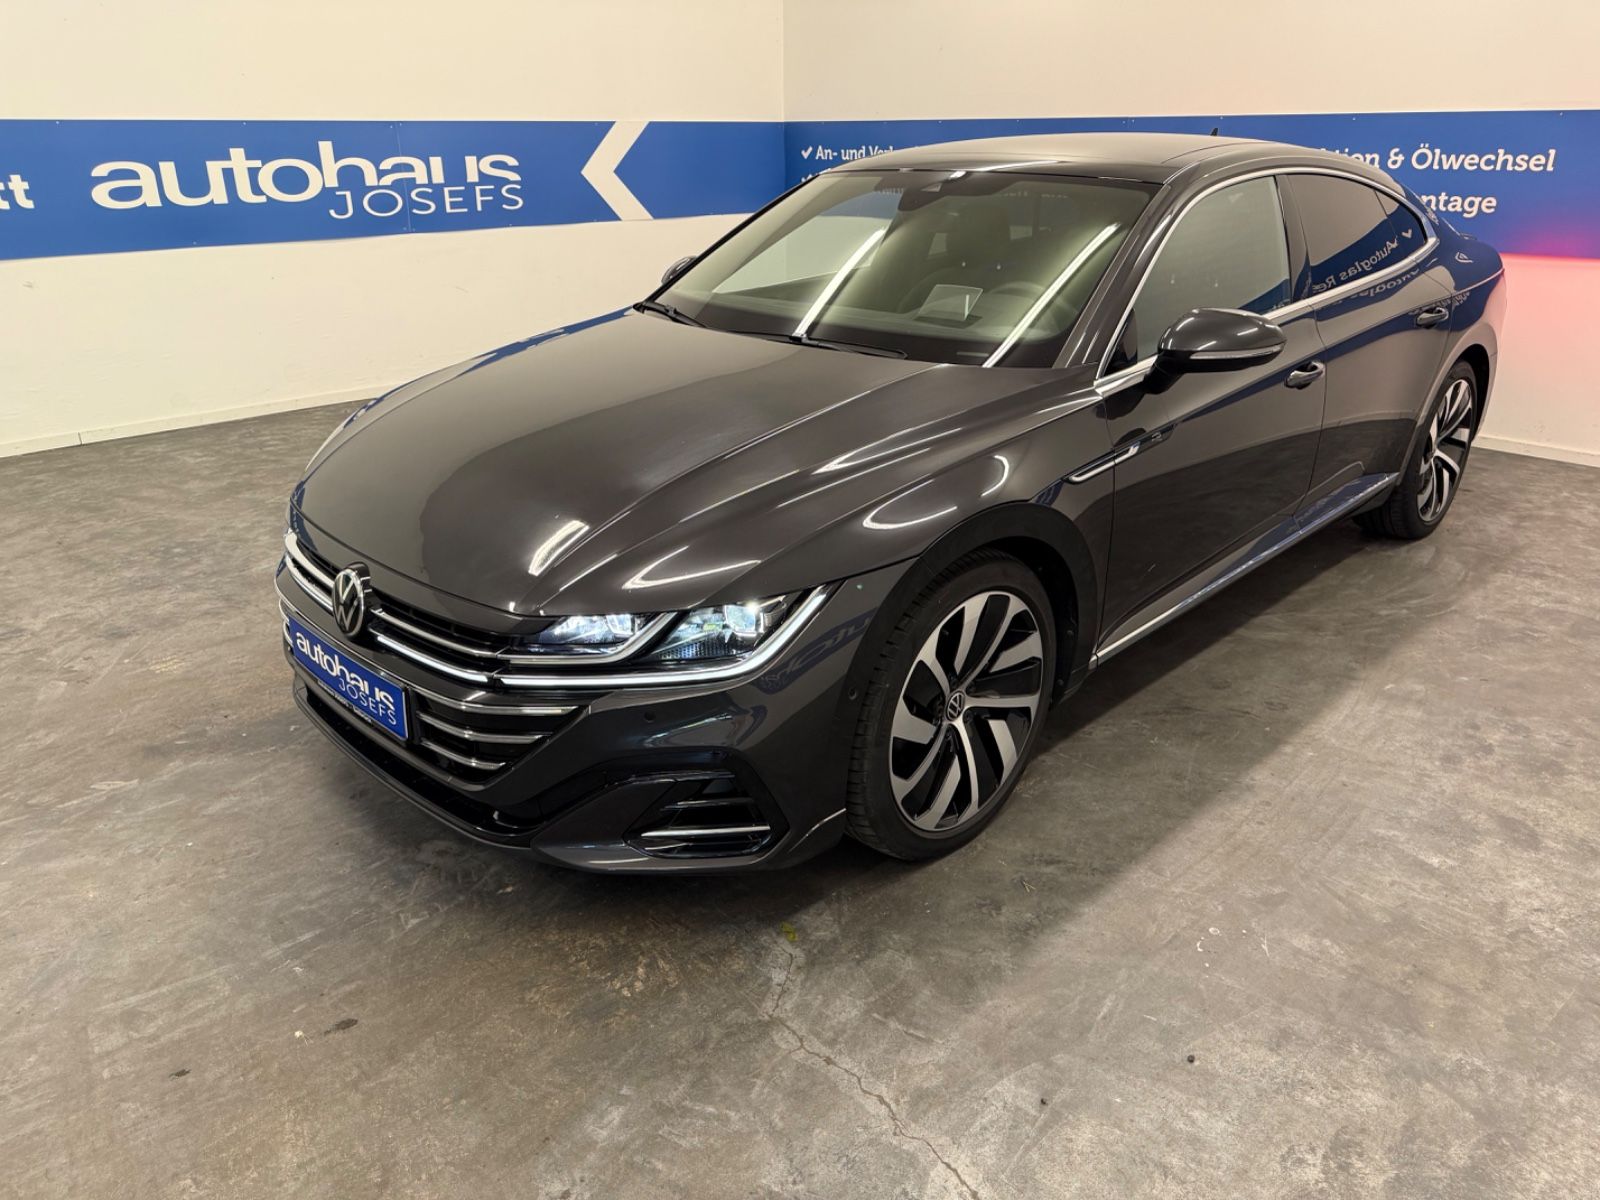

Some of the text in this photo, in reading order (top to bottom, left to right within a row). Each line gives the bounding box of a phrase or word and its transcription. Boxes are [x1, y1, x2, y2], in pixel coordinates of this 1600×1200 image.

[815, 146, 838, 160] An-
[841, 145, 865, 161] und
[1387, 148, 1405, 169] &
[1411, 143, 1556, 171] Ölwechsel
[90, 140, 521, 209] autohaus
[328, 183, 524, 220] JOSEFS
[296, 631, 395, 711] autohaus
[338, 678, 397, 726] JOSEFS
